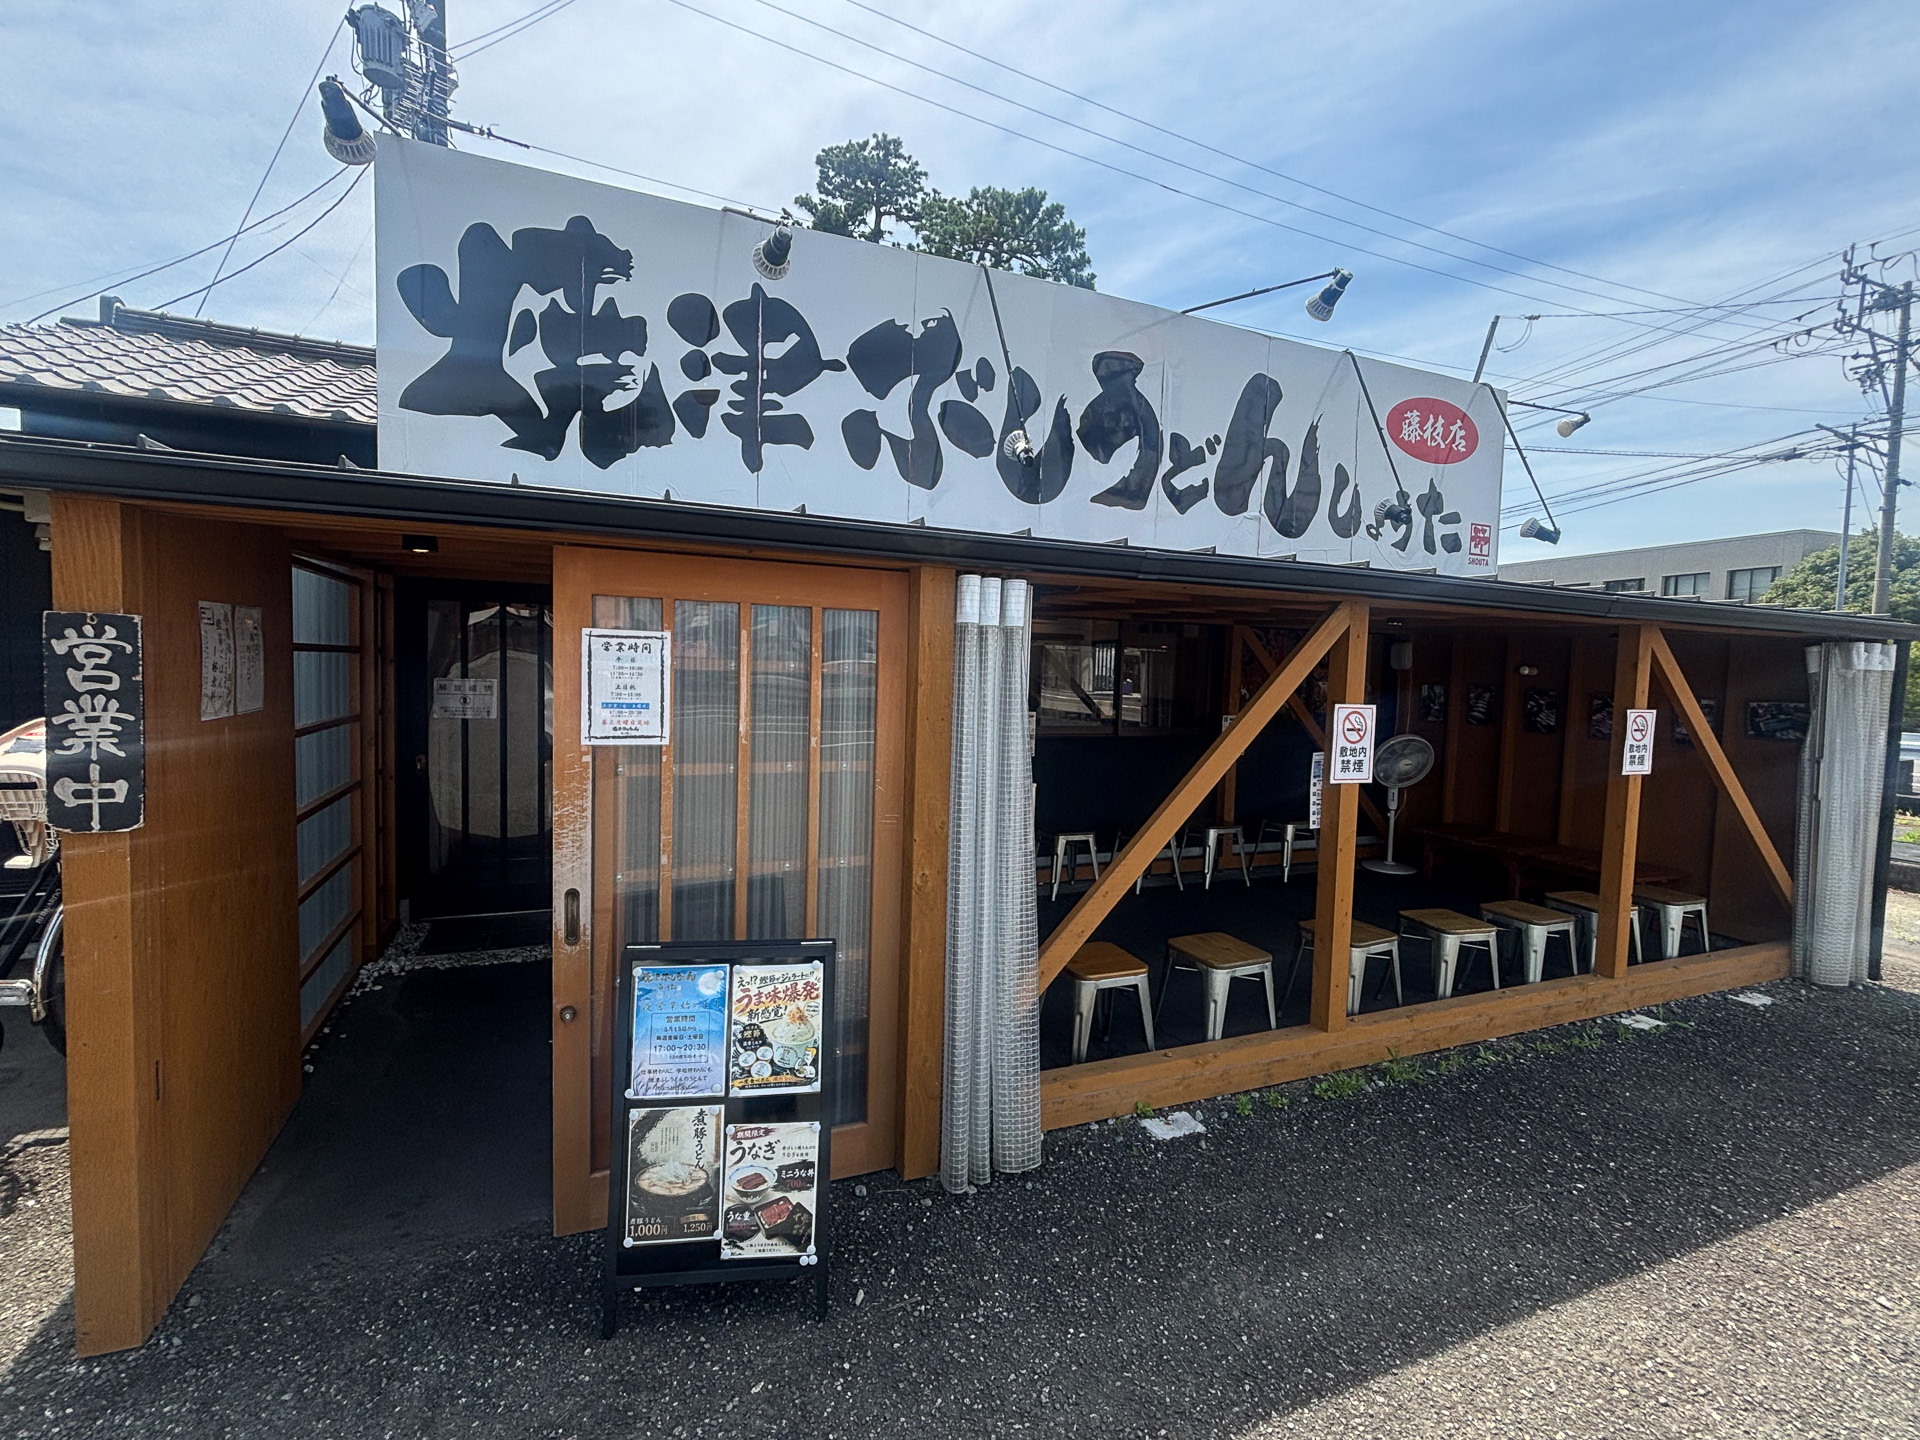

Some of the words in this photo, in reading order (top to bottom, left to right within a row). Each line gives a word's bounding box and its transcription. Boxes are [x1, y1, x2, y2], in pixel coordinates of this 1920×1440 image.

[1399, 410, 1467, 453] 藤枝店
[1468, 557, 1489, 567] SHOUTA
[601, 641, 652, 654] 営業時間
[50, 624, 136, 832] 営業中
[1339, 745, 1368, 758] 敷地内
[1628, 743, 1648, 754] 敷地内
[1340, 759, 1364, 773] 禁煙
[1628, 754, 1646, 766] 禁煙
[735, 980, 820, 1015] うま味爆発
[665, 1015, 696, 1023] 営業時間
[691, 1108, 709, 1169] 煮豚うどん
[736, 1129, 766, 1139] 期間限定
[728, 1140, 780, 1168] うなぎ
[781, 1168, 815, 1178] ミニうな丼
[727, 1211, 751, 1222] うな重
